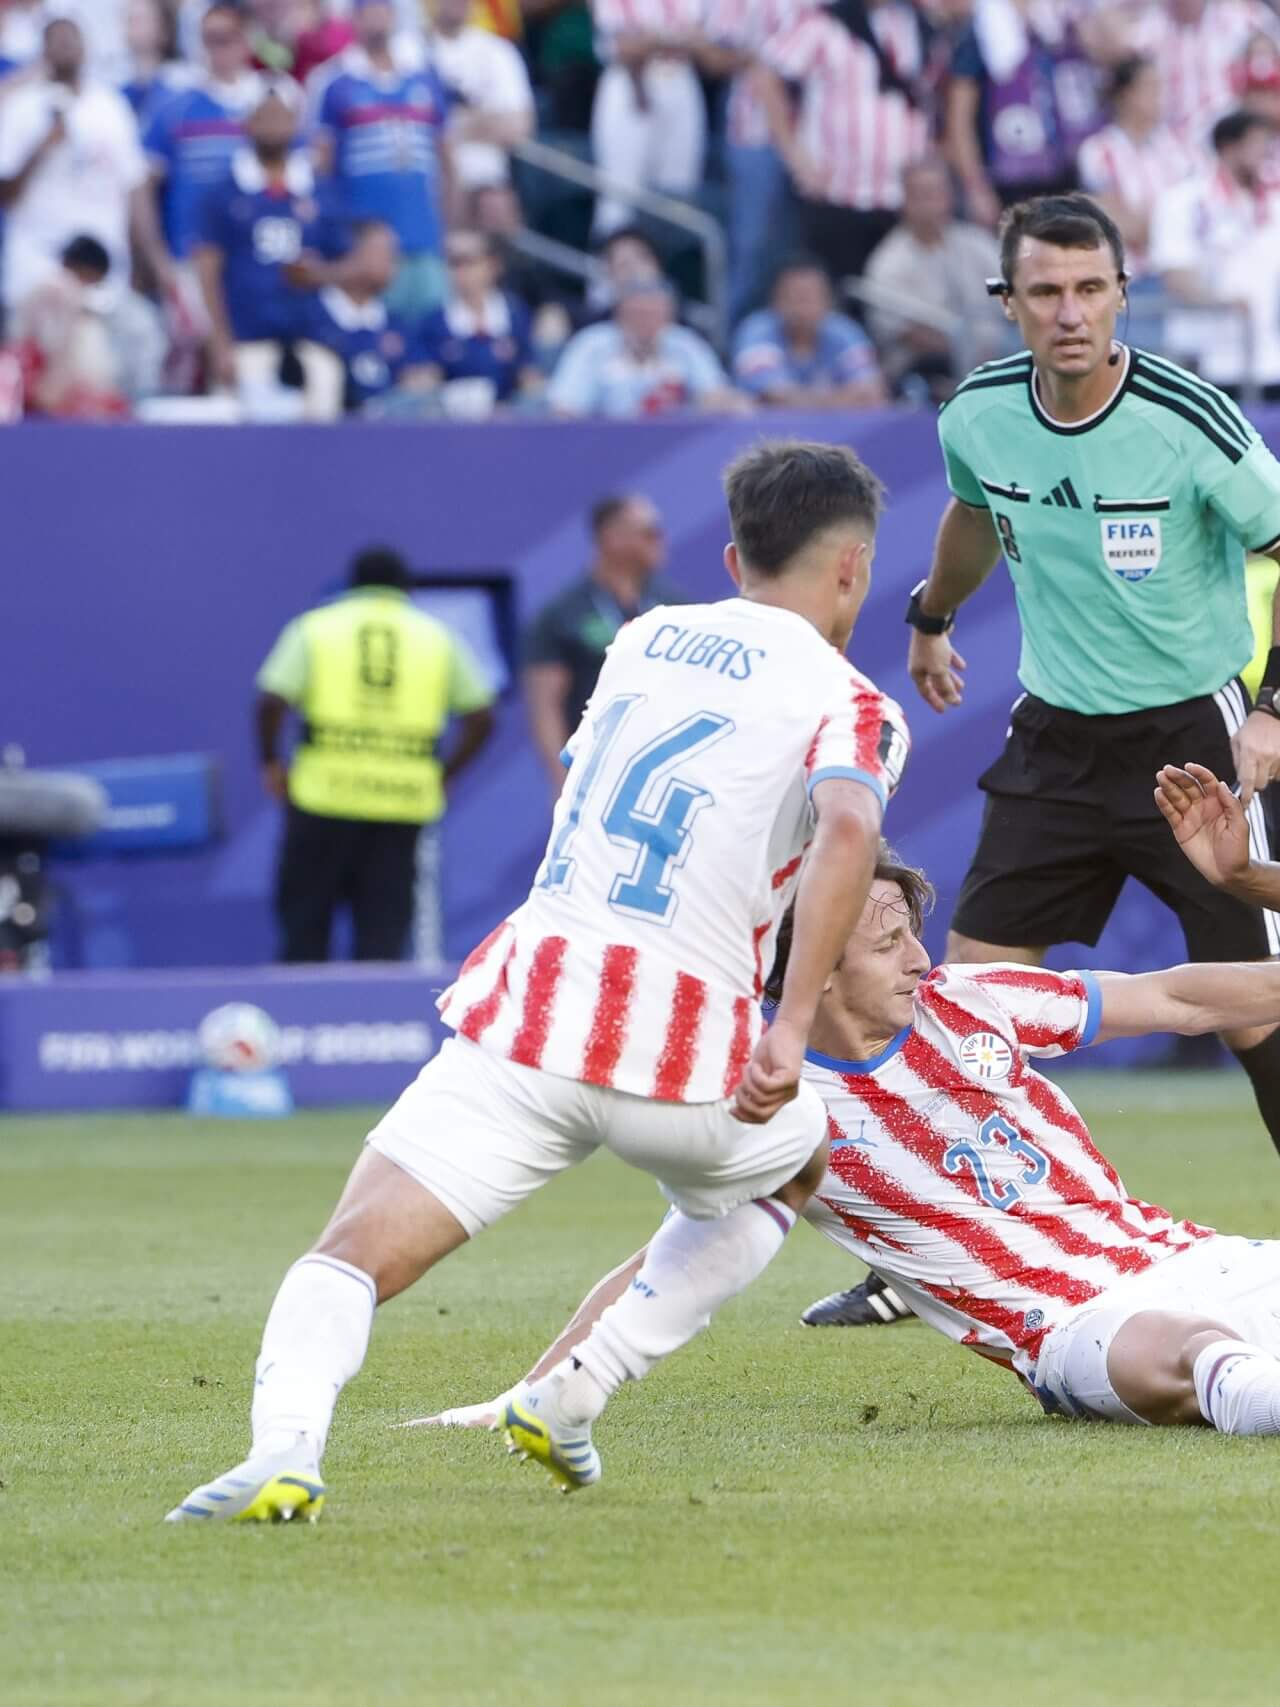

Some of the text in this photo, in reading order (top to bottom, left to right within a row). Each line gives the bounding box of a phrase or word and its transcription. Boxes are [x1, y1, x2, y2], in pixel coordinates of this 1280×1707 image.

[1107, 523, 1154, 540] FIFA
[1108, 547, 1156, 559] REFEREE
[644, 624, 766, 680] CUBAS
[533, 693, 736, 929] 14
[963, 1036, 980, 1053] APF
[943, 1113, 1050, 1211] 23
